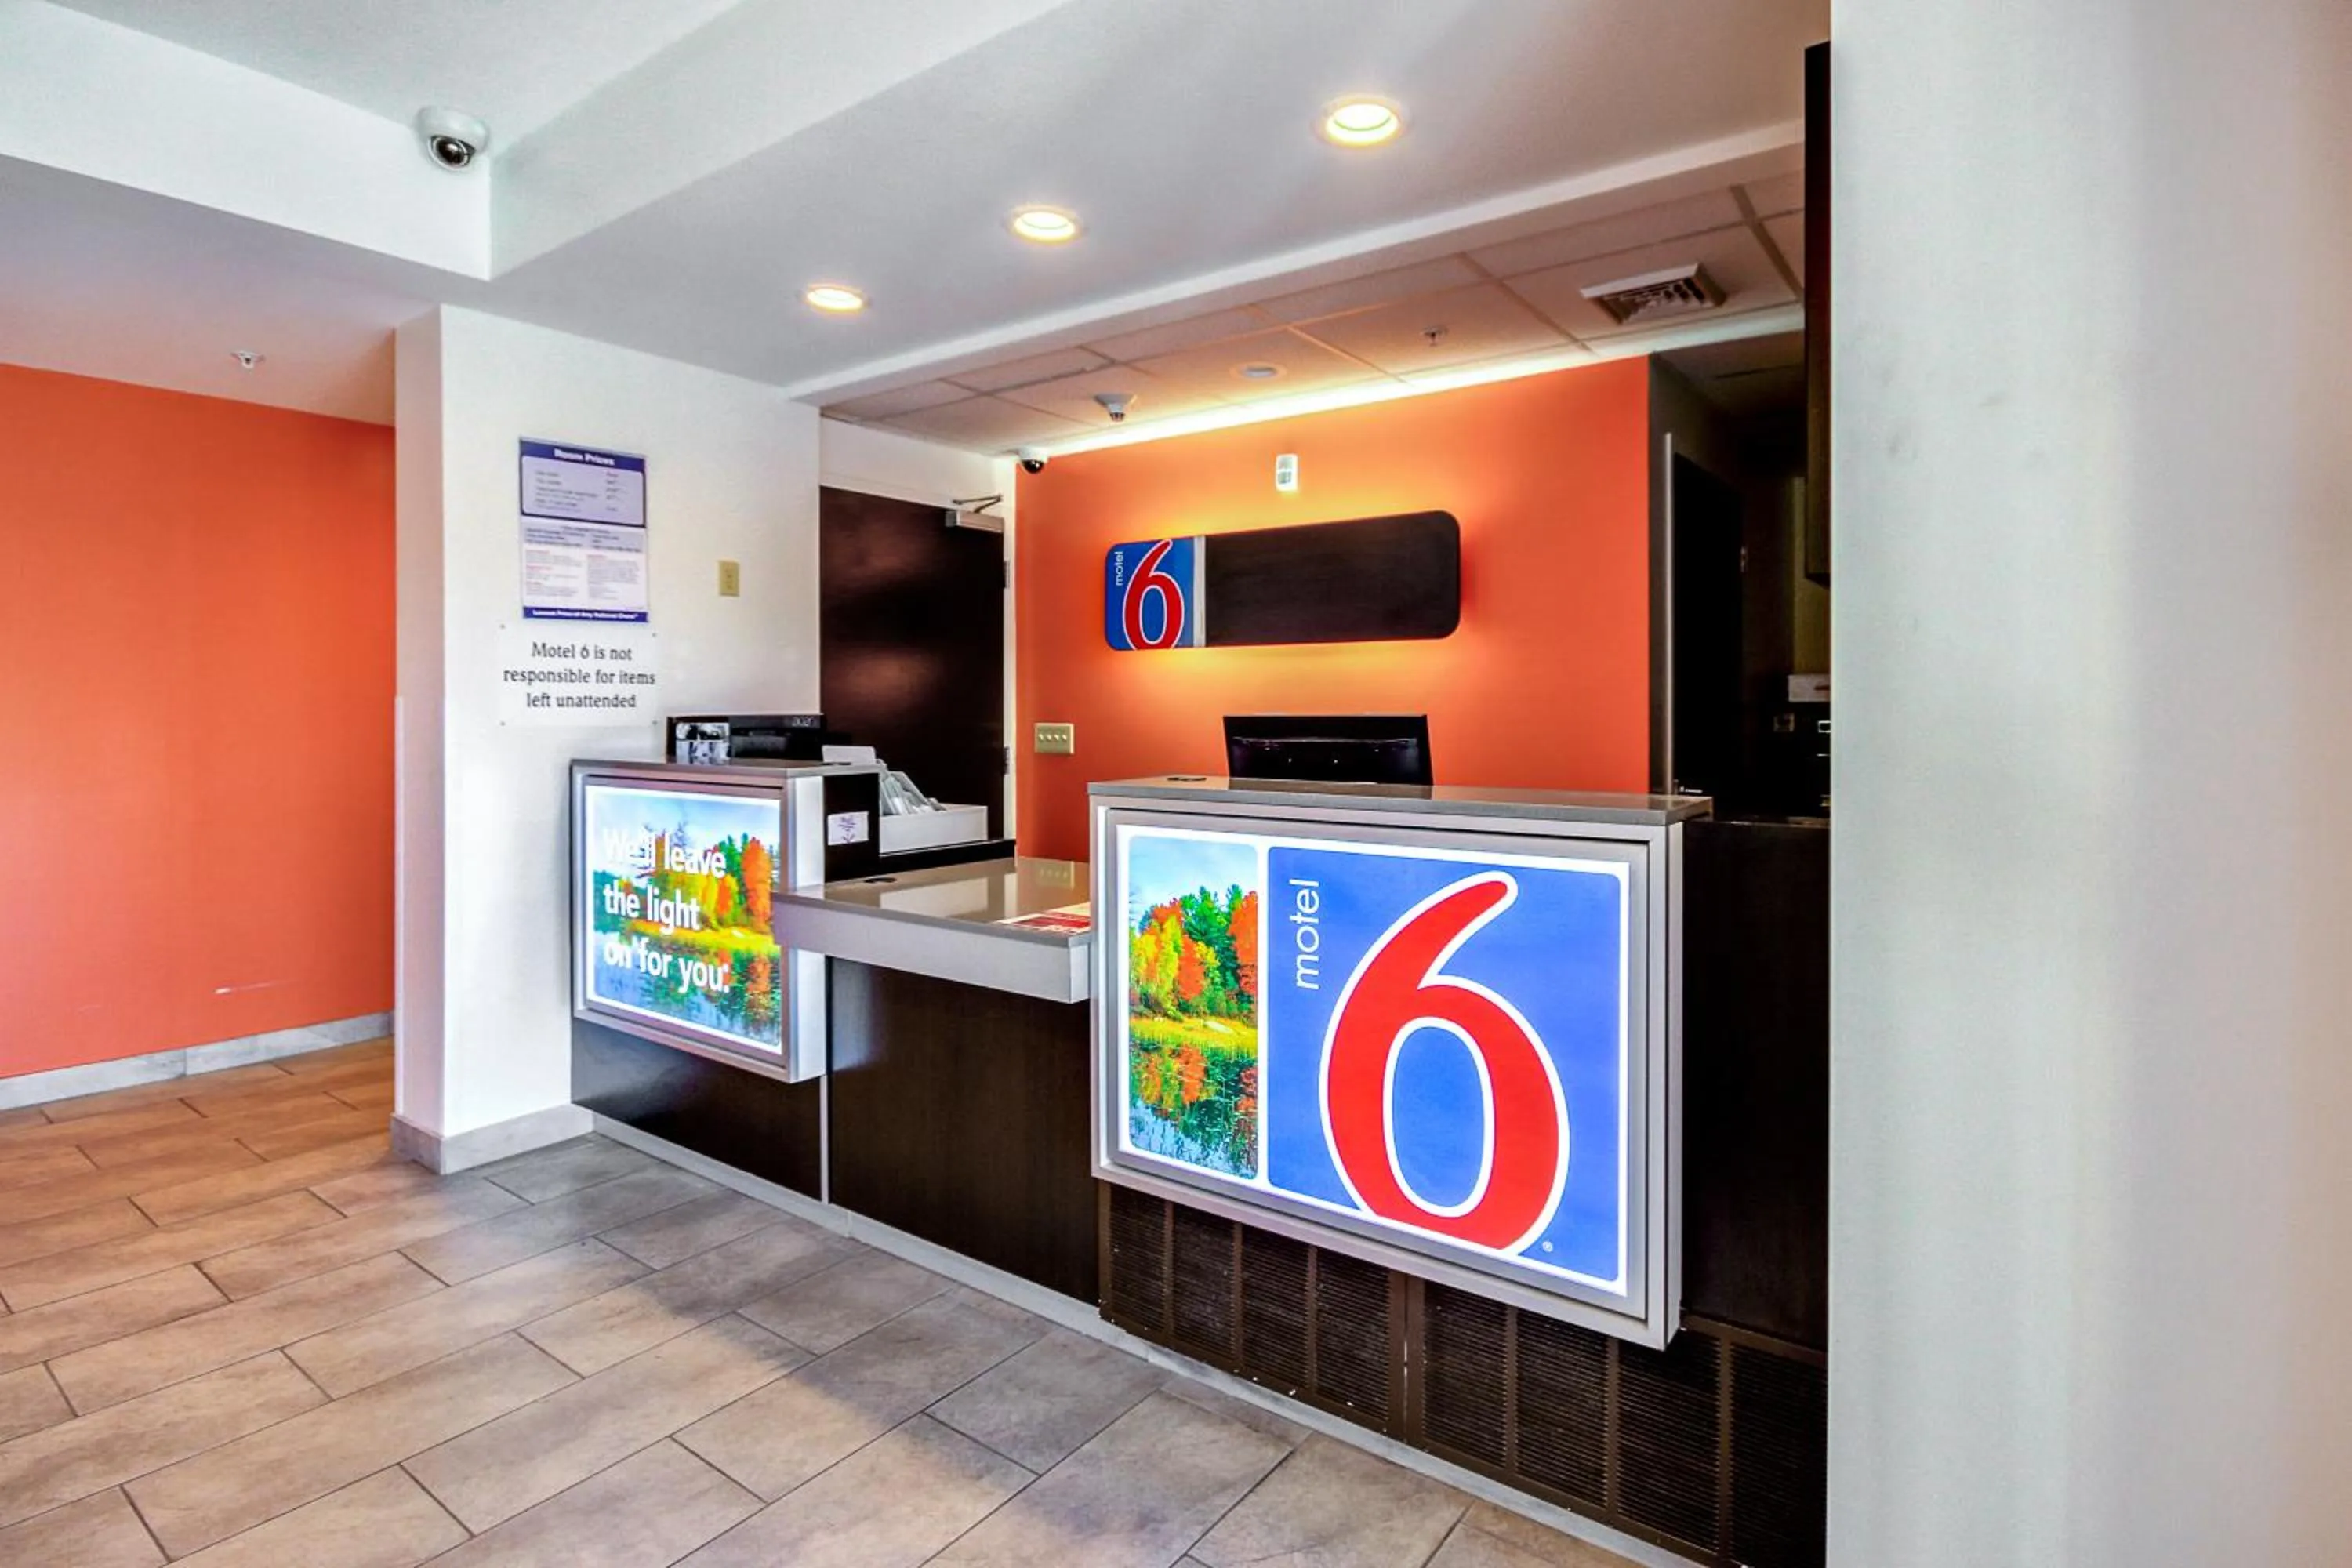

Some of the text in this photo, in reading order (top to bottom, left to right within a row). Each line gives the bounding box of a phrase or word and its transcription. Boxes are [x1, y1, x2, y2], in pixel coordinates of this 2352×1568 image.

[1114, 539, 1185, 650] motel 6
[531, 641, 632, 660] Motel 6 is not
[503, 668, 655, 685] responsible for items
[527, 693, 637, 708] left unattended
[665, 832, 727, 878] leave
[603, 878, 701, 935] the light
[604, 941, 632, 969] on
[638, 938, 673, 978] for
[1289, 870, 1570, 1256] motel 6
